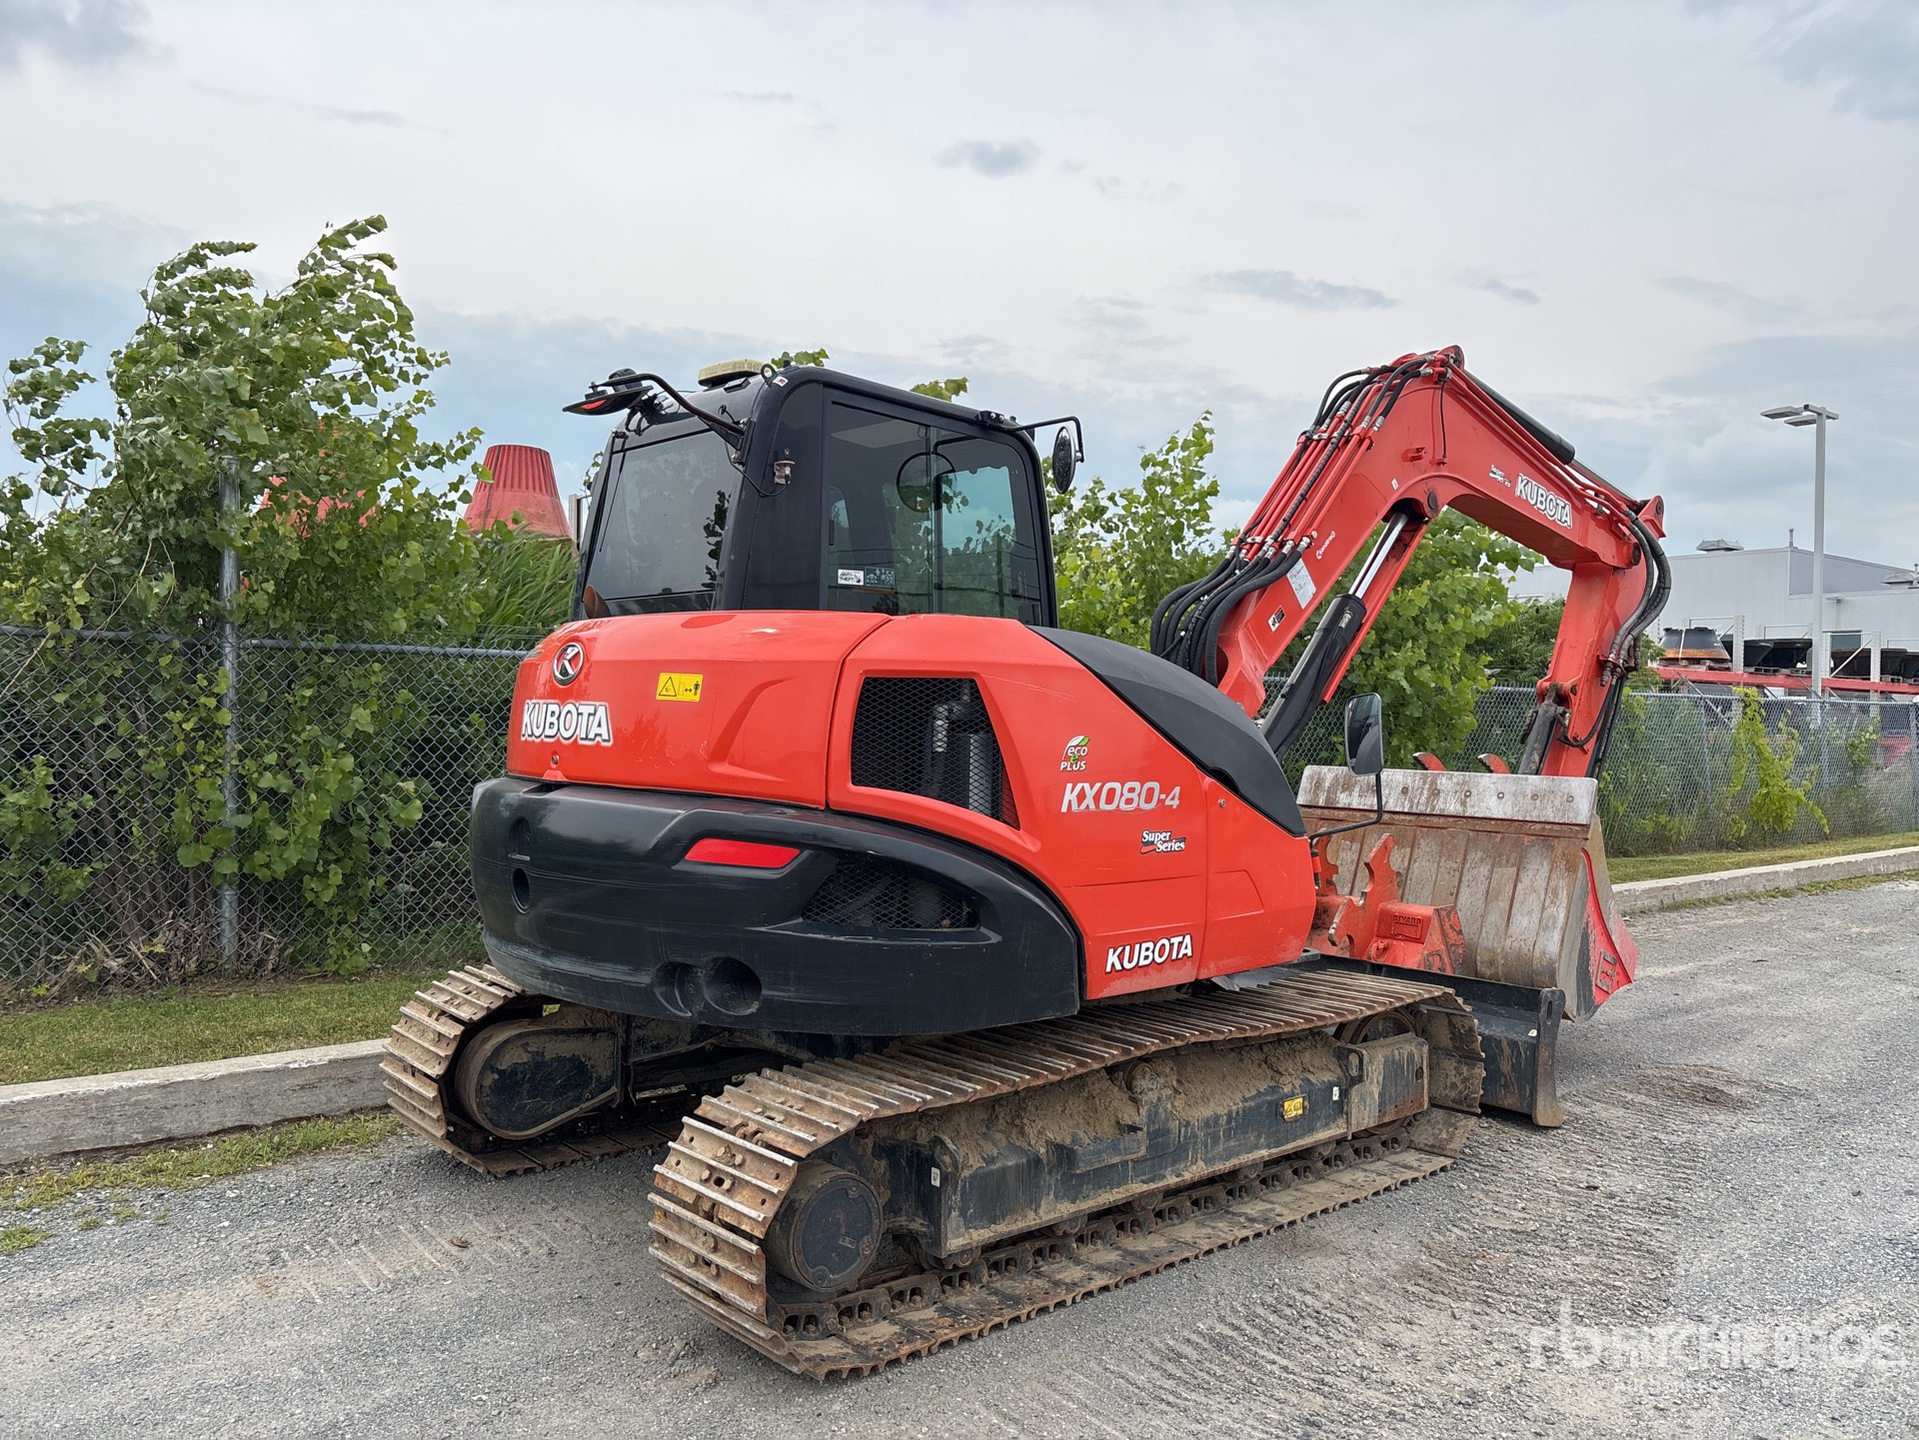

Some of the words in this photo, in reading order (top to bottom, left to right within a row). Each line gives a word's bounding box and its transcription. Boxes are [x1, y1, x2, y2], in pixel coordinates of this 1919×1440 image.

[1516, 473, 1572, 529] KUBOTA
[522, 701, 612, 743] KUBOTA
[1067, 746, 1089, 757] eco
[1060, 761, 1087, 771] PLUS
[1060, 781, 1181, 813] KX080-4
[1141, 830, 1172, 845] Super
[1155, 840, 1185, 853] Series
[1105, 934, 1193, 973] KUBOTA
